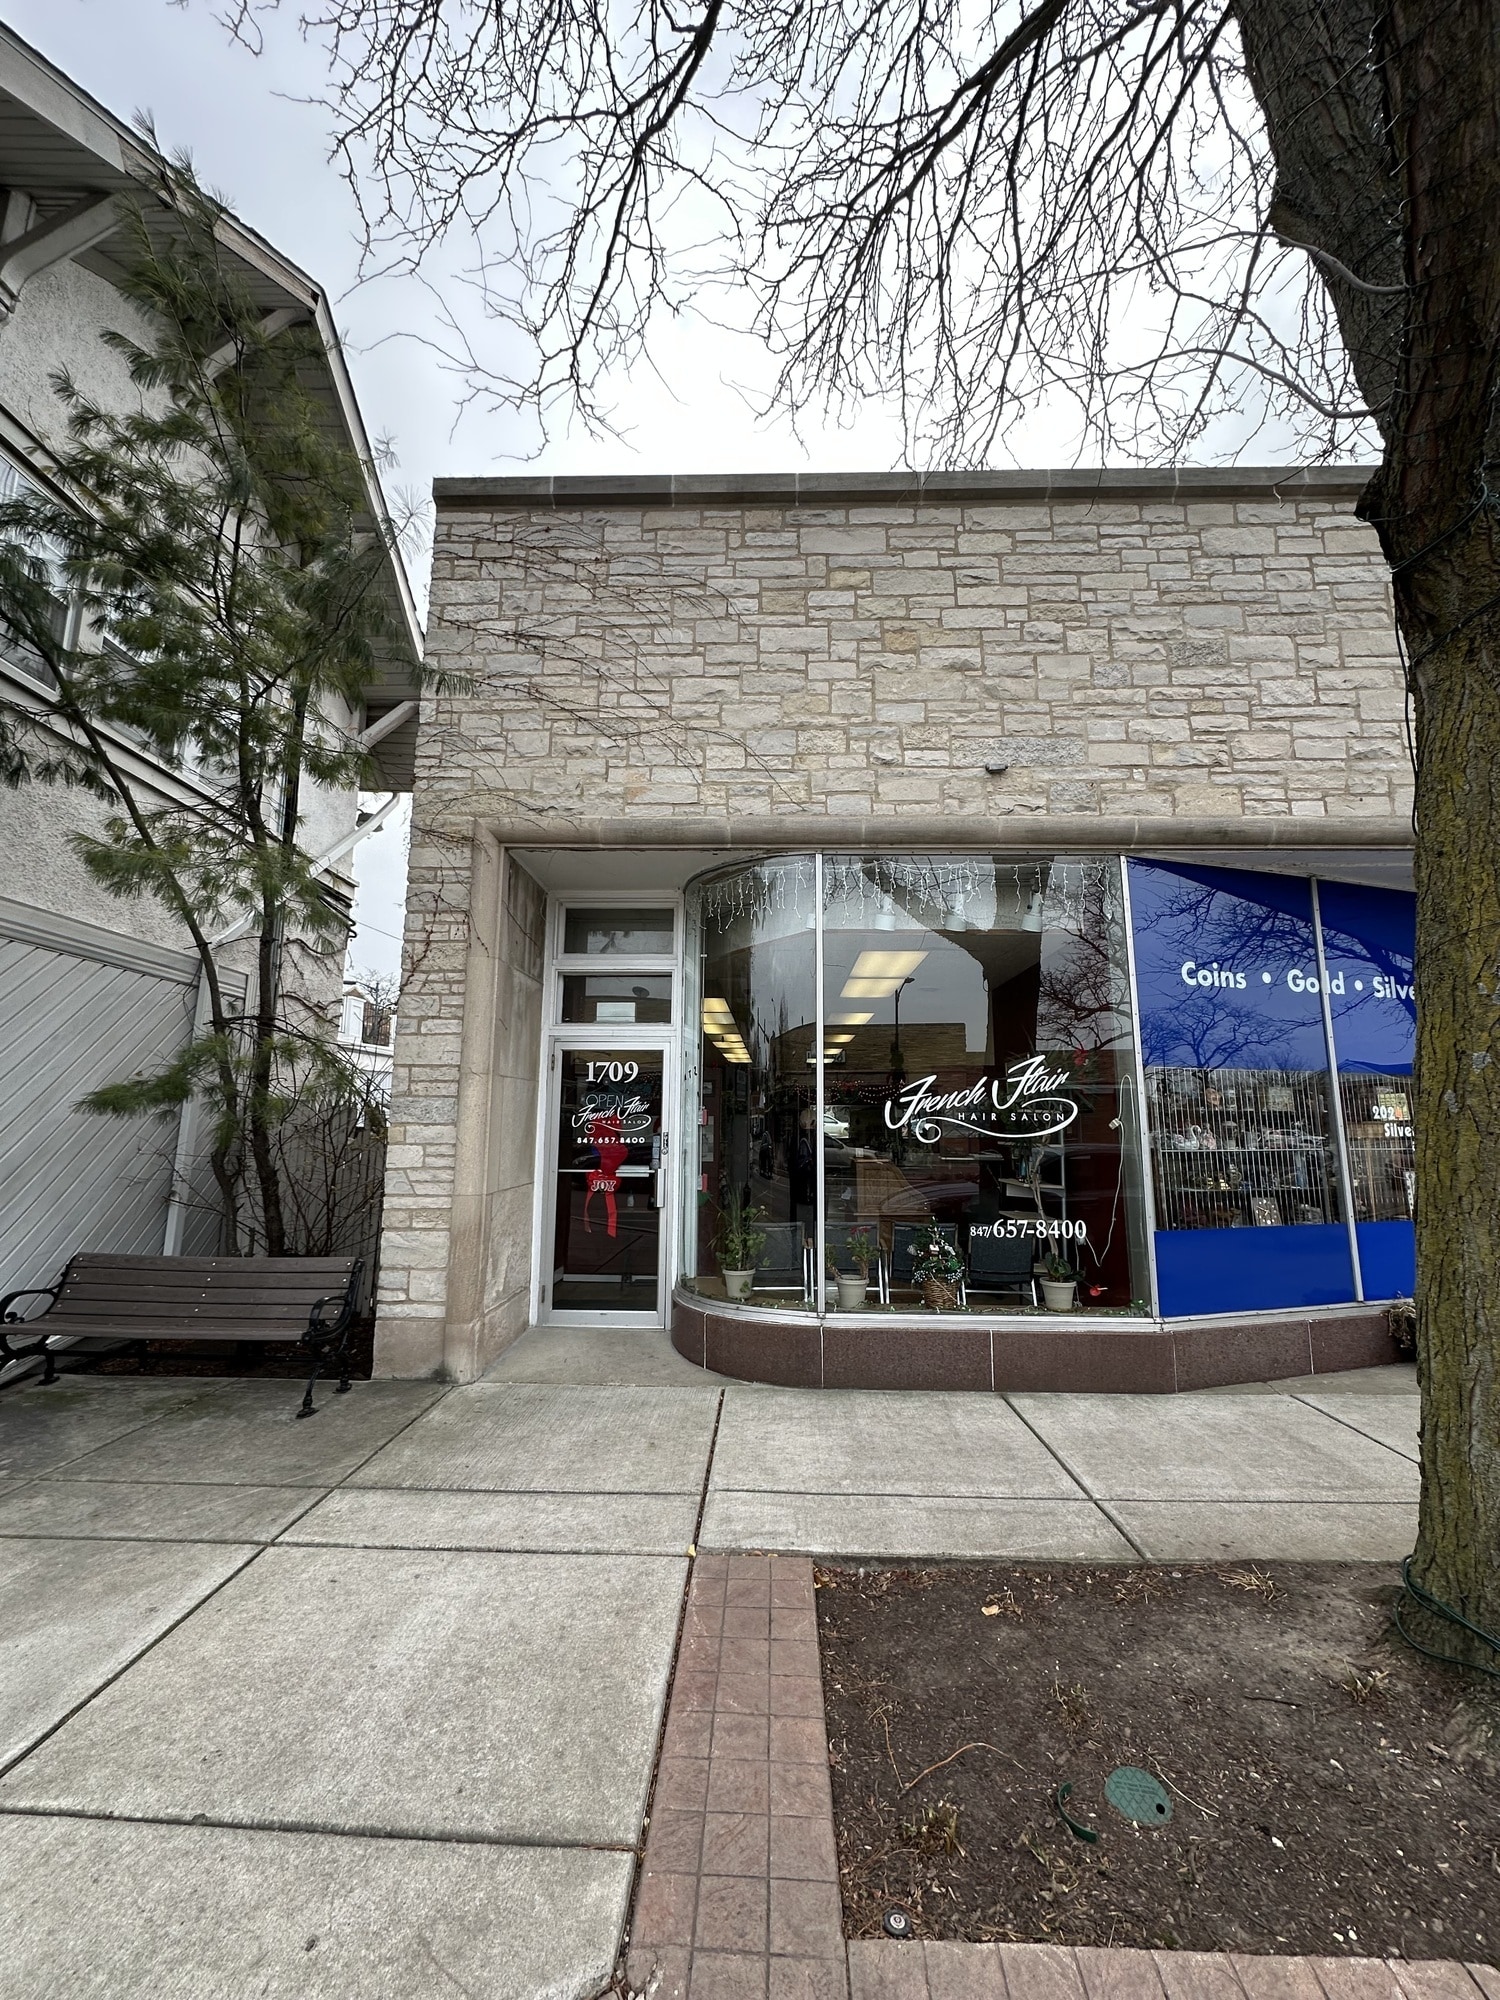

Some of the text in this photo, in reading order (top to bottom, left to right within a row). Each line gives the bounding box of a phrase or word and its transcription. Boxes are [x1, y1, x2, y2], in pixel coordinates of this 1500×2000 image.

[1181, 961, 1247, 989] Coins
[1287, 968, 1346, 995] Gold
[585, 1061, 639, 1083] 1709
[585, 1093, 624, 1108] OPEN
[884, 1054, 1071, 1130] French Flair
[571, 1096, 650, 1128] French Flair
[958, 1112, 1066, 1122] HAIR SALON
[1383, 1122, 1415, 1137] Silve
[576, 1136, 646, 1145] 847.657.8400
[590, 1180, 617, 1192] JOY
[969, 1218, 1088, 1239] 847/657-8400
